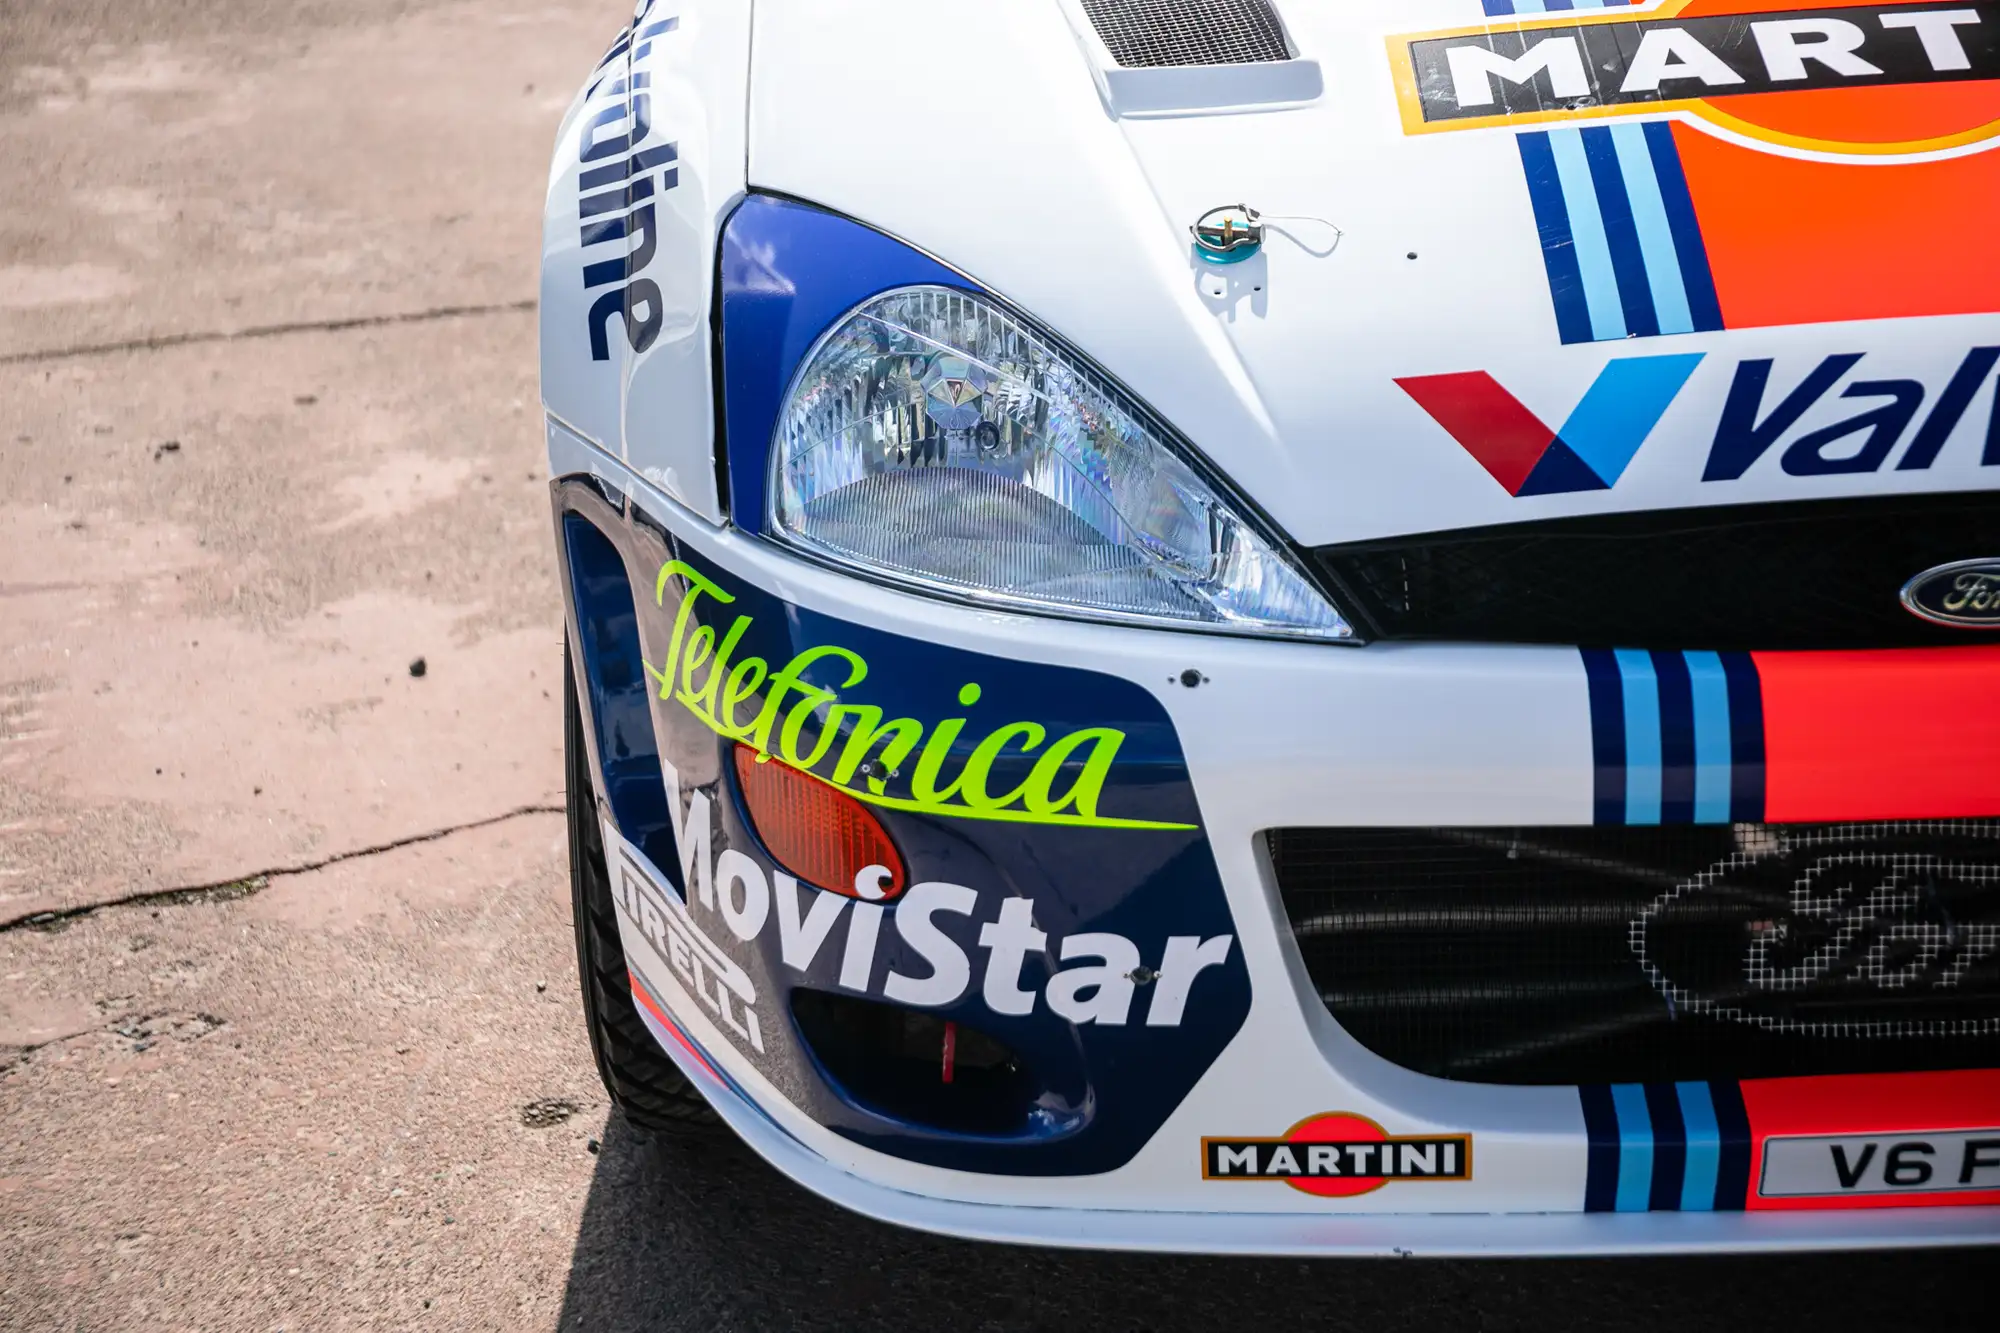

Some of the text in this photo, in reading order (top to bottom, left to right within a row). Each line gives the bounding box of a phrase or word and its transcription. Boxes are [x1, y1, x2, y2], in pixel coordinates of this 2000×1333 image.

[1446, 8, 1981, 108] MART
[1700, 345, 2000, 482] Val
[604, 819, 766, 1054] PIRELLI
[664, 758, 1233, 1026] MoviStar
[1217, 1143, 1456, 1176] MARTINI
[1830, 1141, 1936, 1189] V6
